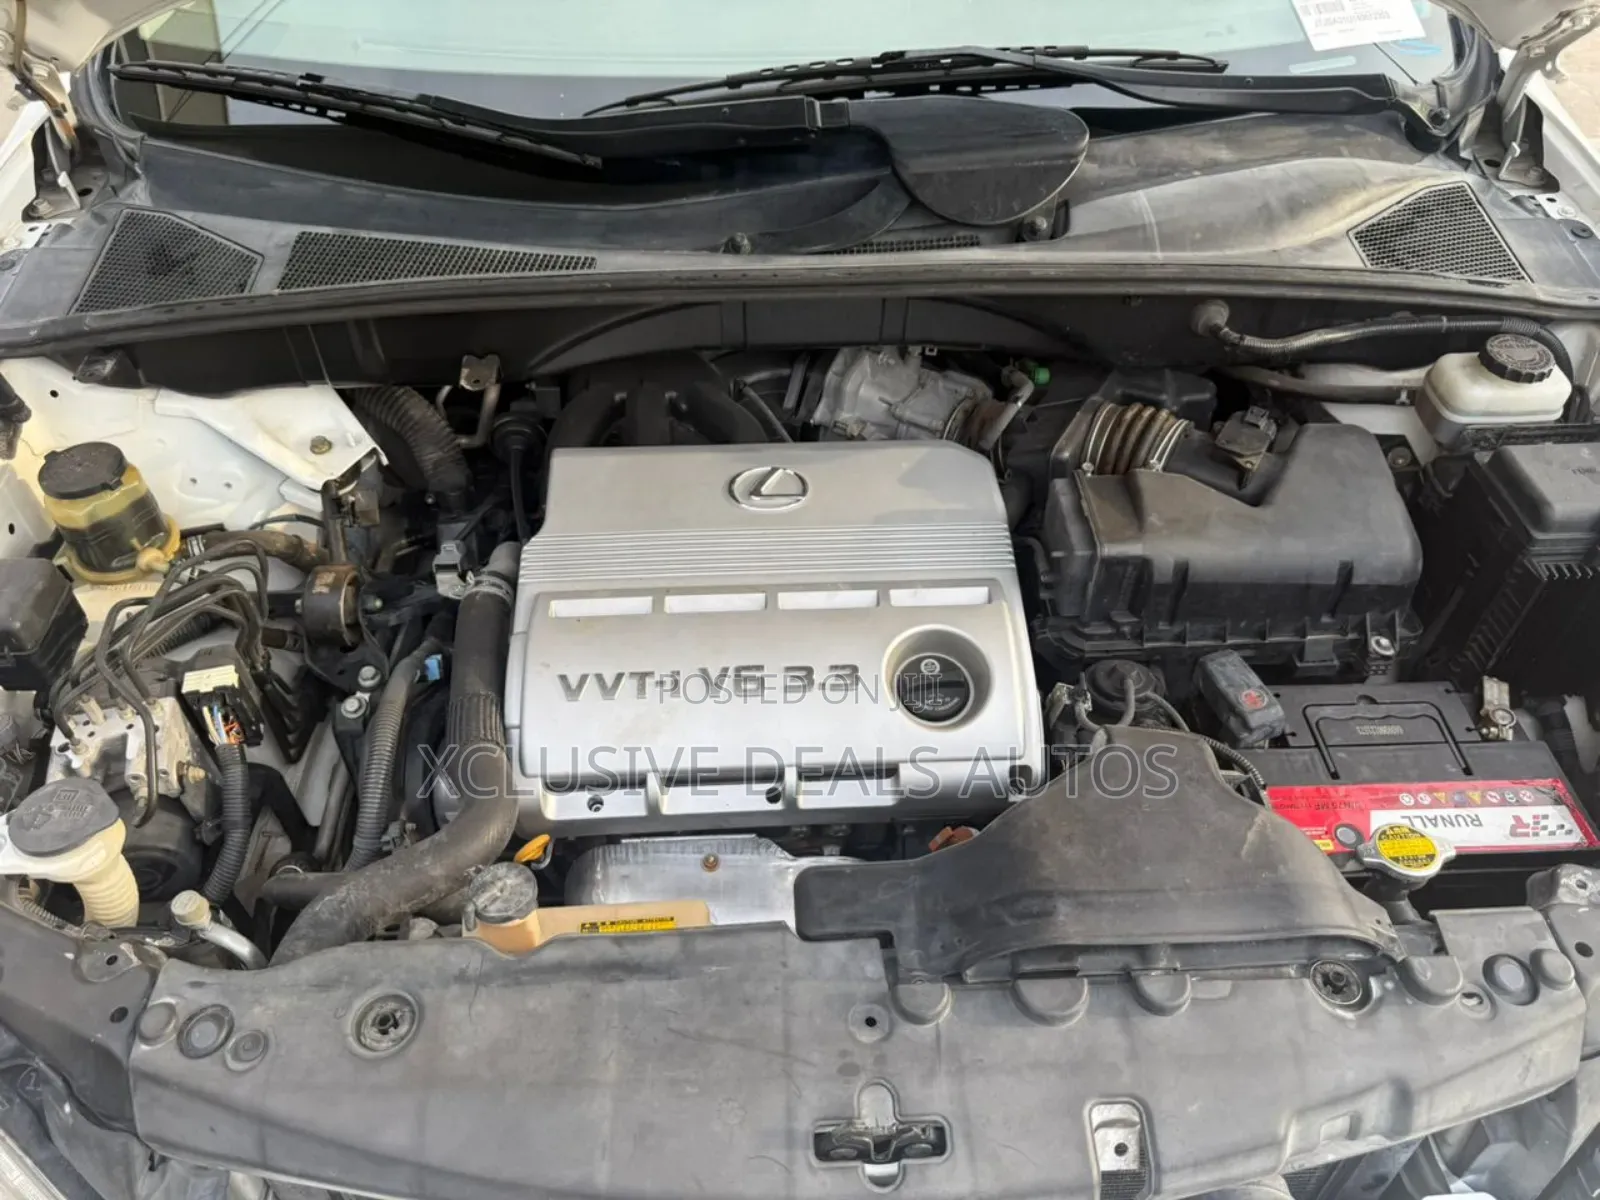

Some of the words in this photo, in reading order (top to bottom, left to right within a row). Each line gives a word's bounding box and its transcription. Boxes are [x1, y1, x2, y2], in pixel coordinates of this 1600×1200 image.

[698, 665, 765, 699] V6
[783, 664, 859, 694] 3.3
[1400, 813, 1484, 829] RUNALL
